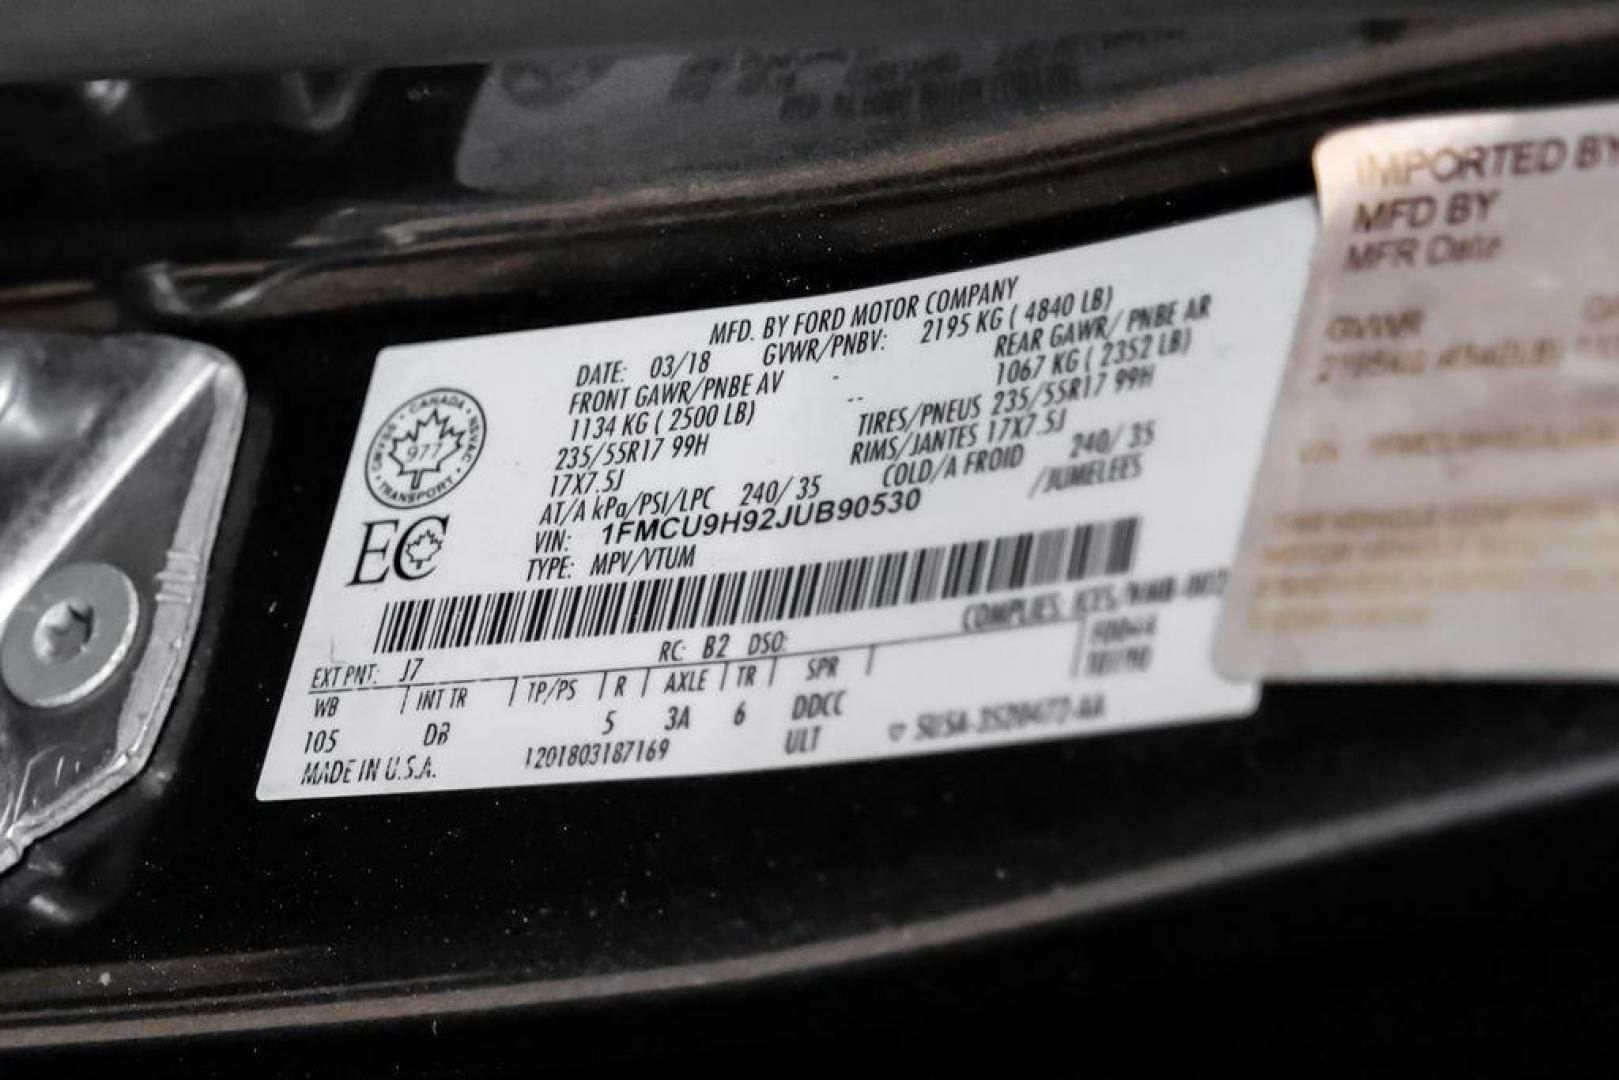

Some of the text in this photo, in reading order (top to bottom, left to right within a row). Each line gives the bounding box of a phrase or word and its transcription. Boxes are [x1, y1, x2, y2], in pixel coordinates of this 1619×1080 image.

[1358, 137, 1567, 186] IMPORTED
[1353, 190, 1501, 234] MFD BY
[1344, 237, 1419, 272] MFR
[709, 276, 1020, 345] MFD. BY FORD MOTOR COMPANY
[762, 329, 888, 368] GVWR/PNBV:
[920, 311, 970, 344] 2195
[976, 307, 1004, 333] KG
[1024, 291, 1075, 323] 4840
[1080, 285, 1114, 314] LB)
[994, 326, 1046, 359] REAR
[1184, 294, 1213, 320] AR
[576, 350, 712, 388] DATE: 03/18
[995, 355, 1047, 385] 1067
[1052, 350, 1080, 376] KG
[1101, 335, 1153, 367] 2352
[1157, 328, 1193, 356] LB)
[568, 370, 785, 416] FRONT GAWR/PNBE AV
[857, 363, 1157, 437] TIRES/PNEUS 235/55R17 99H
[571, 417, 615, 441] 1134
[621, 412, 648, 436] KG
[668, 405, 720, 432] 2500
[723, 400, 757, 427] LB)
[555, 434, 710, 471] 235/55R17 99H
[850, 423, 978, 465] RIMS/JANTES
[883, 443, 1026, 487] COLD/A FROID
[550, 468, 626, 498] 17X7.5J
[535, 487, 923, 556] VIN: 1FMCU9H92JUB90530
[539, 497, 586, 526] AT/A
[592, 486, 716, 523] kPa/PSI/LPC
[527, 544, 697, 582] TYPE: MPV/VTUM
[701, 634, 731, 659] B2
[311, 658, 425, 690] EXT PNT: J7
[663, 669, 709, 694] AXLE
[737, 665, 758, 687] TR
[805, 656, 840, 682] SPR
[415, 687, 469, 712] INT TR
[528, 678, 579, 706] TP/PS
[614, 676, 628, 697] R
[314, 697, 340, 718] WB
[601, 709, 618, 735] 5
[664, 705, 691, 731] 3A
[733, 700, 747, 728] 6
[791, 690, 847, 722] DDCC
[304, 729, 340, 755] 105
[523, 738, 671, 770] 1201803187169
[783, 726, 823, 755] ULT
[301, 755, 437, 786] MADE IN U.S.A.
